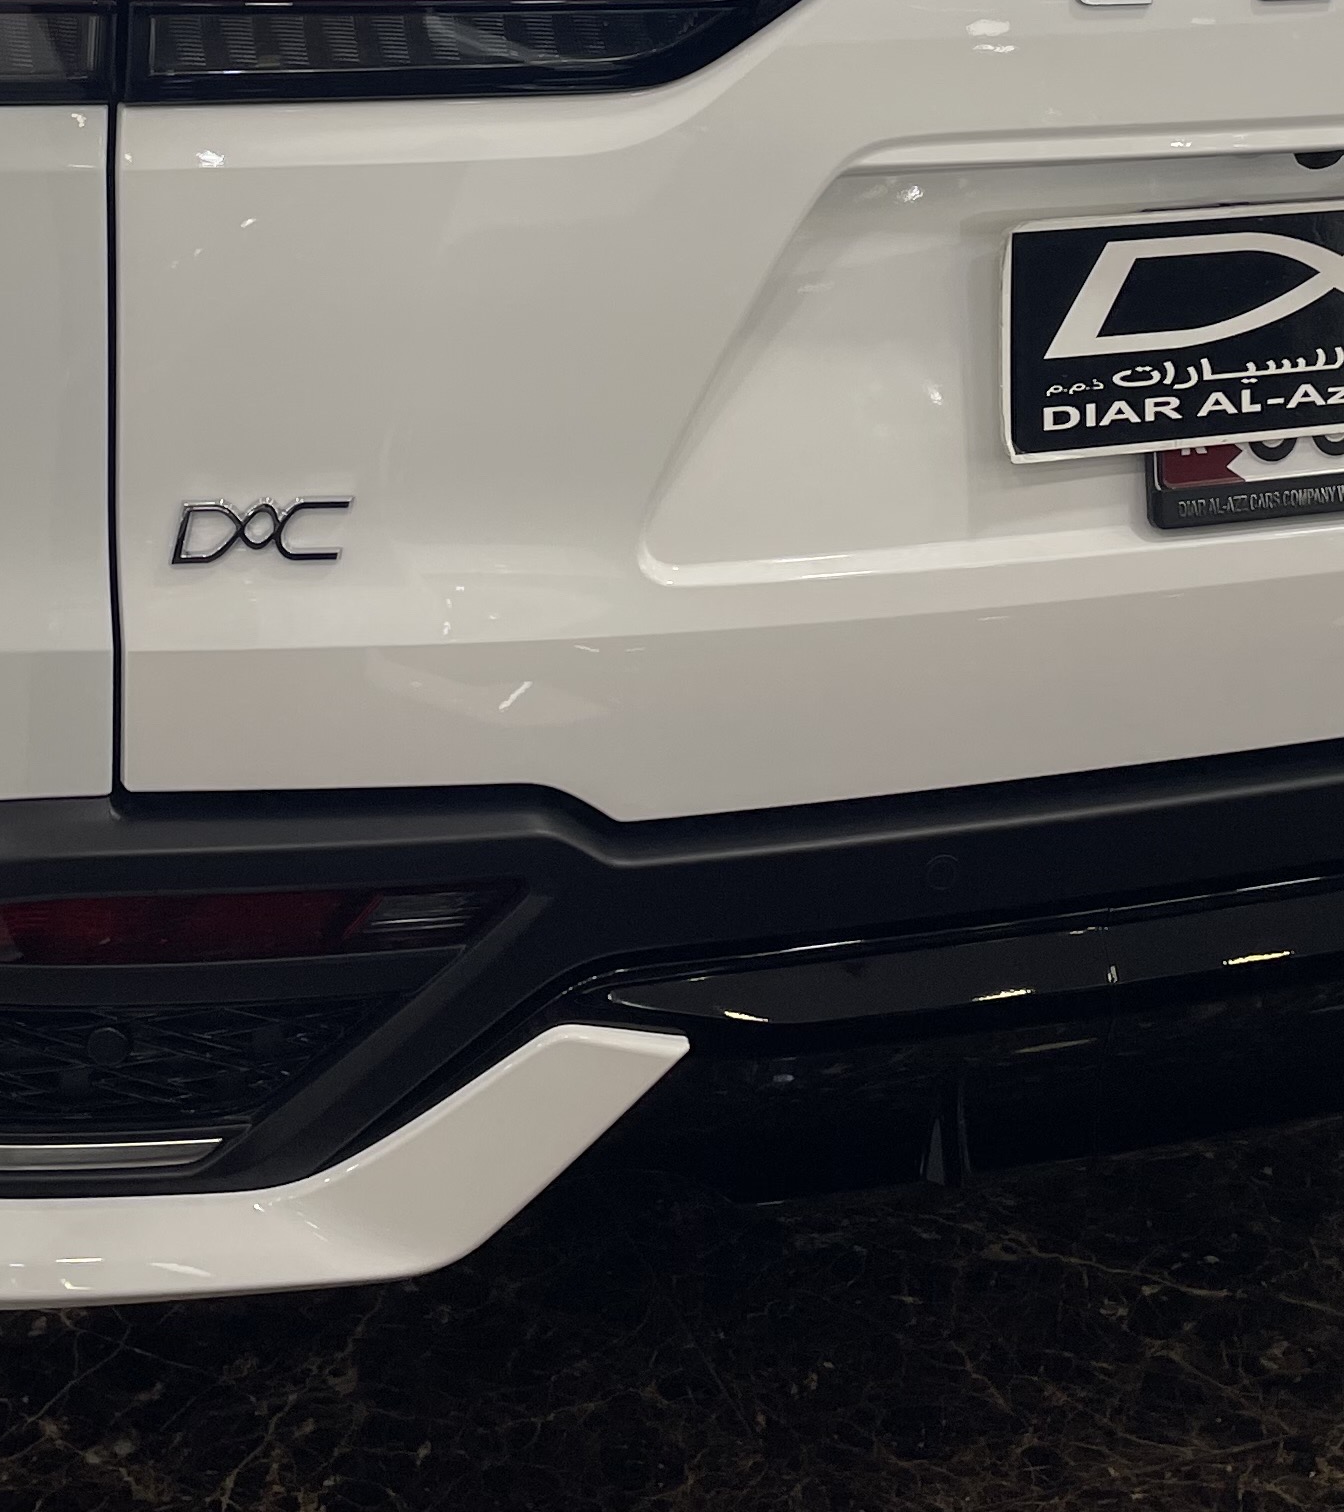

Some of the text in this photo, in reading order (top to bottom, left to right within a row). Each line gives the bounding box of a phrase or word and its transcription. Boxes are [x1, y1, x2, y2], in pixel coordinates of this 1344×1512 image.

[1043, 396, 1183, 432] DIAR
[1178, 500, 1205, 518] DIAR
[1208, 494, 1250, 514] AL-AZZ
[1250, 491, 1281, 510] CARS
[1283, 485, 1336, 507] COMPANY
